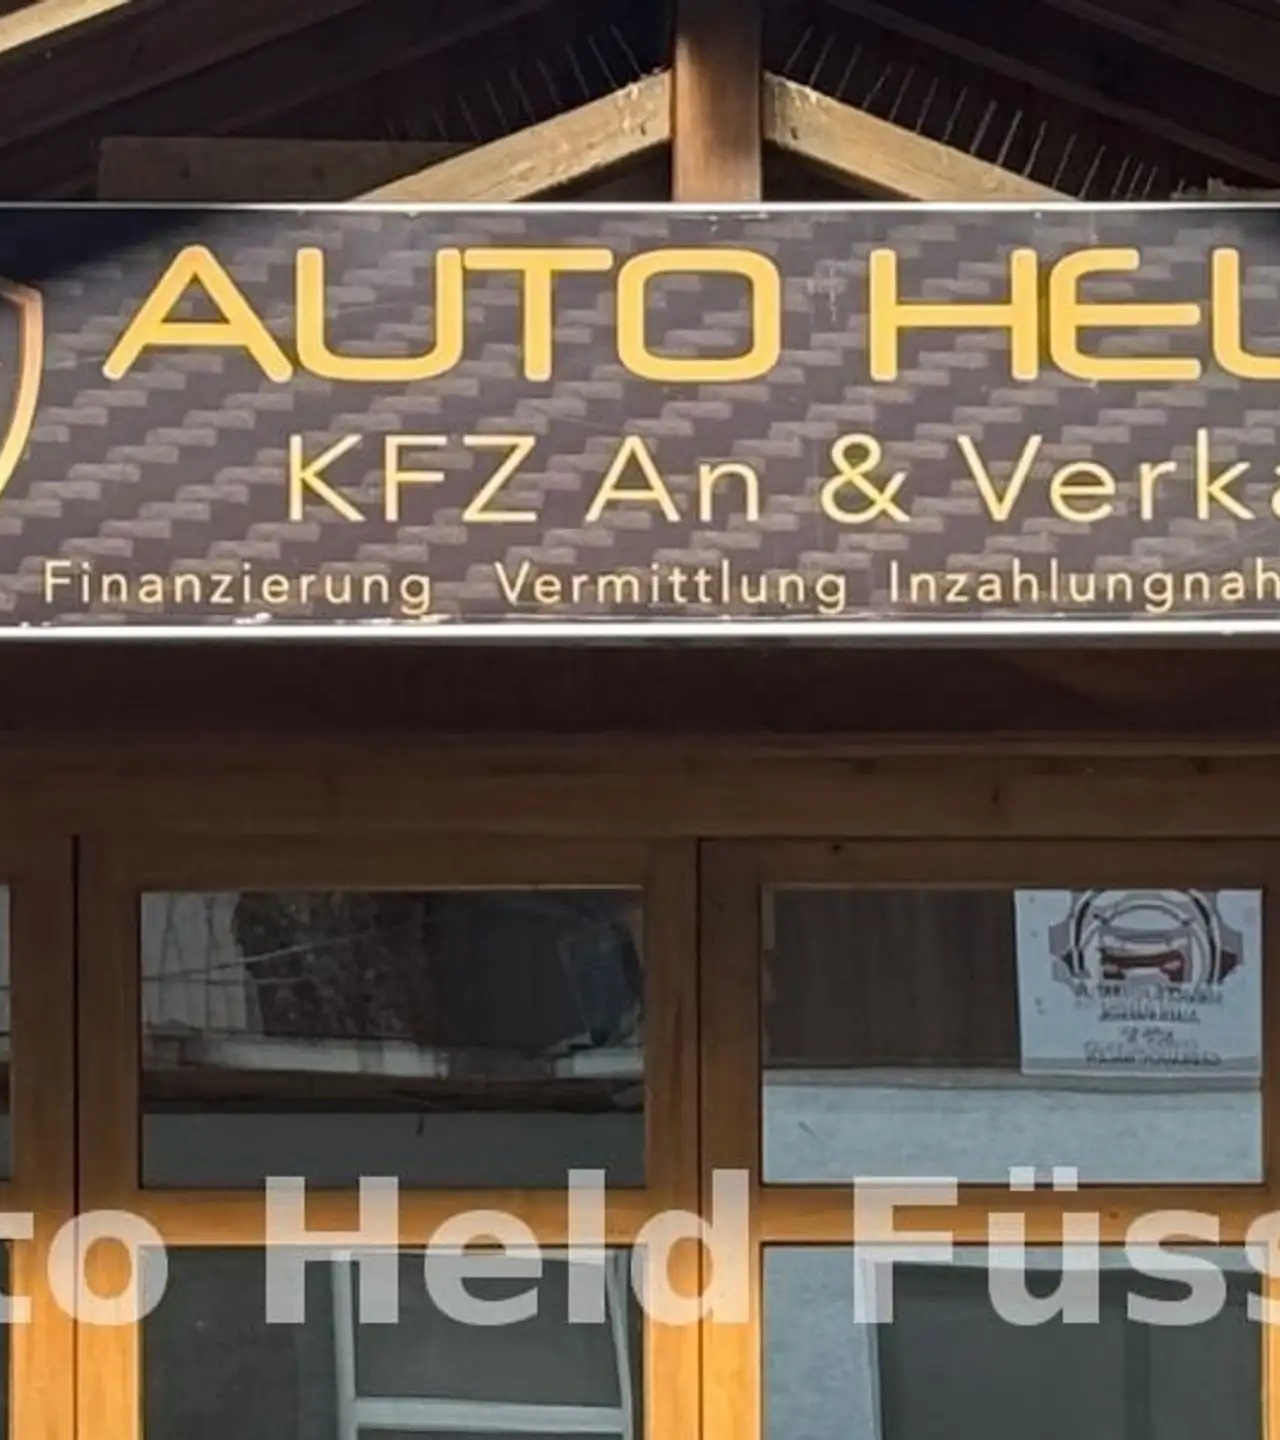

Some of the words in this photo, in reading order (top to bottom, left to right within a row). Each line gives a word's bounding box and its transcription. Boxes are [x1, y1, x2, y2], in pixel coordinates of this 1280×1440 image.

[101, 244, 781, 385] AUTO
[287, 434, 538, 523] KFZ
[584, 434, 761, 523] An
[820, 432, 911, 523] &
[43, 559, 432, 614] Finanzierung
[494, 559, 848, 612] Vermittlung
